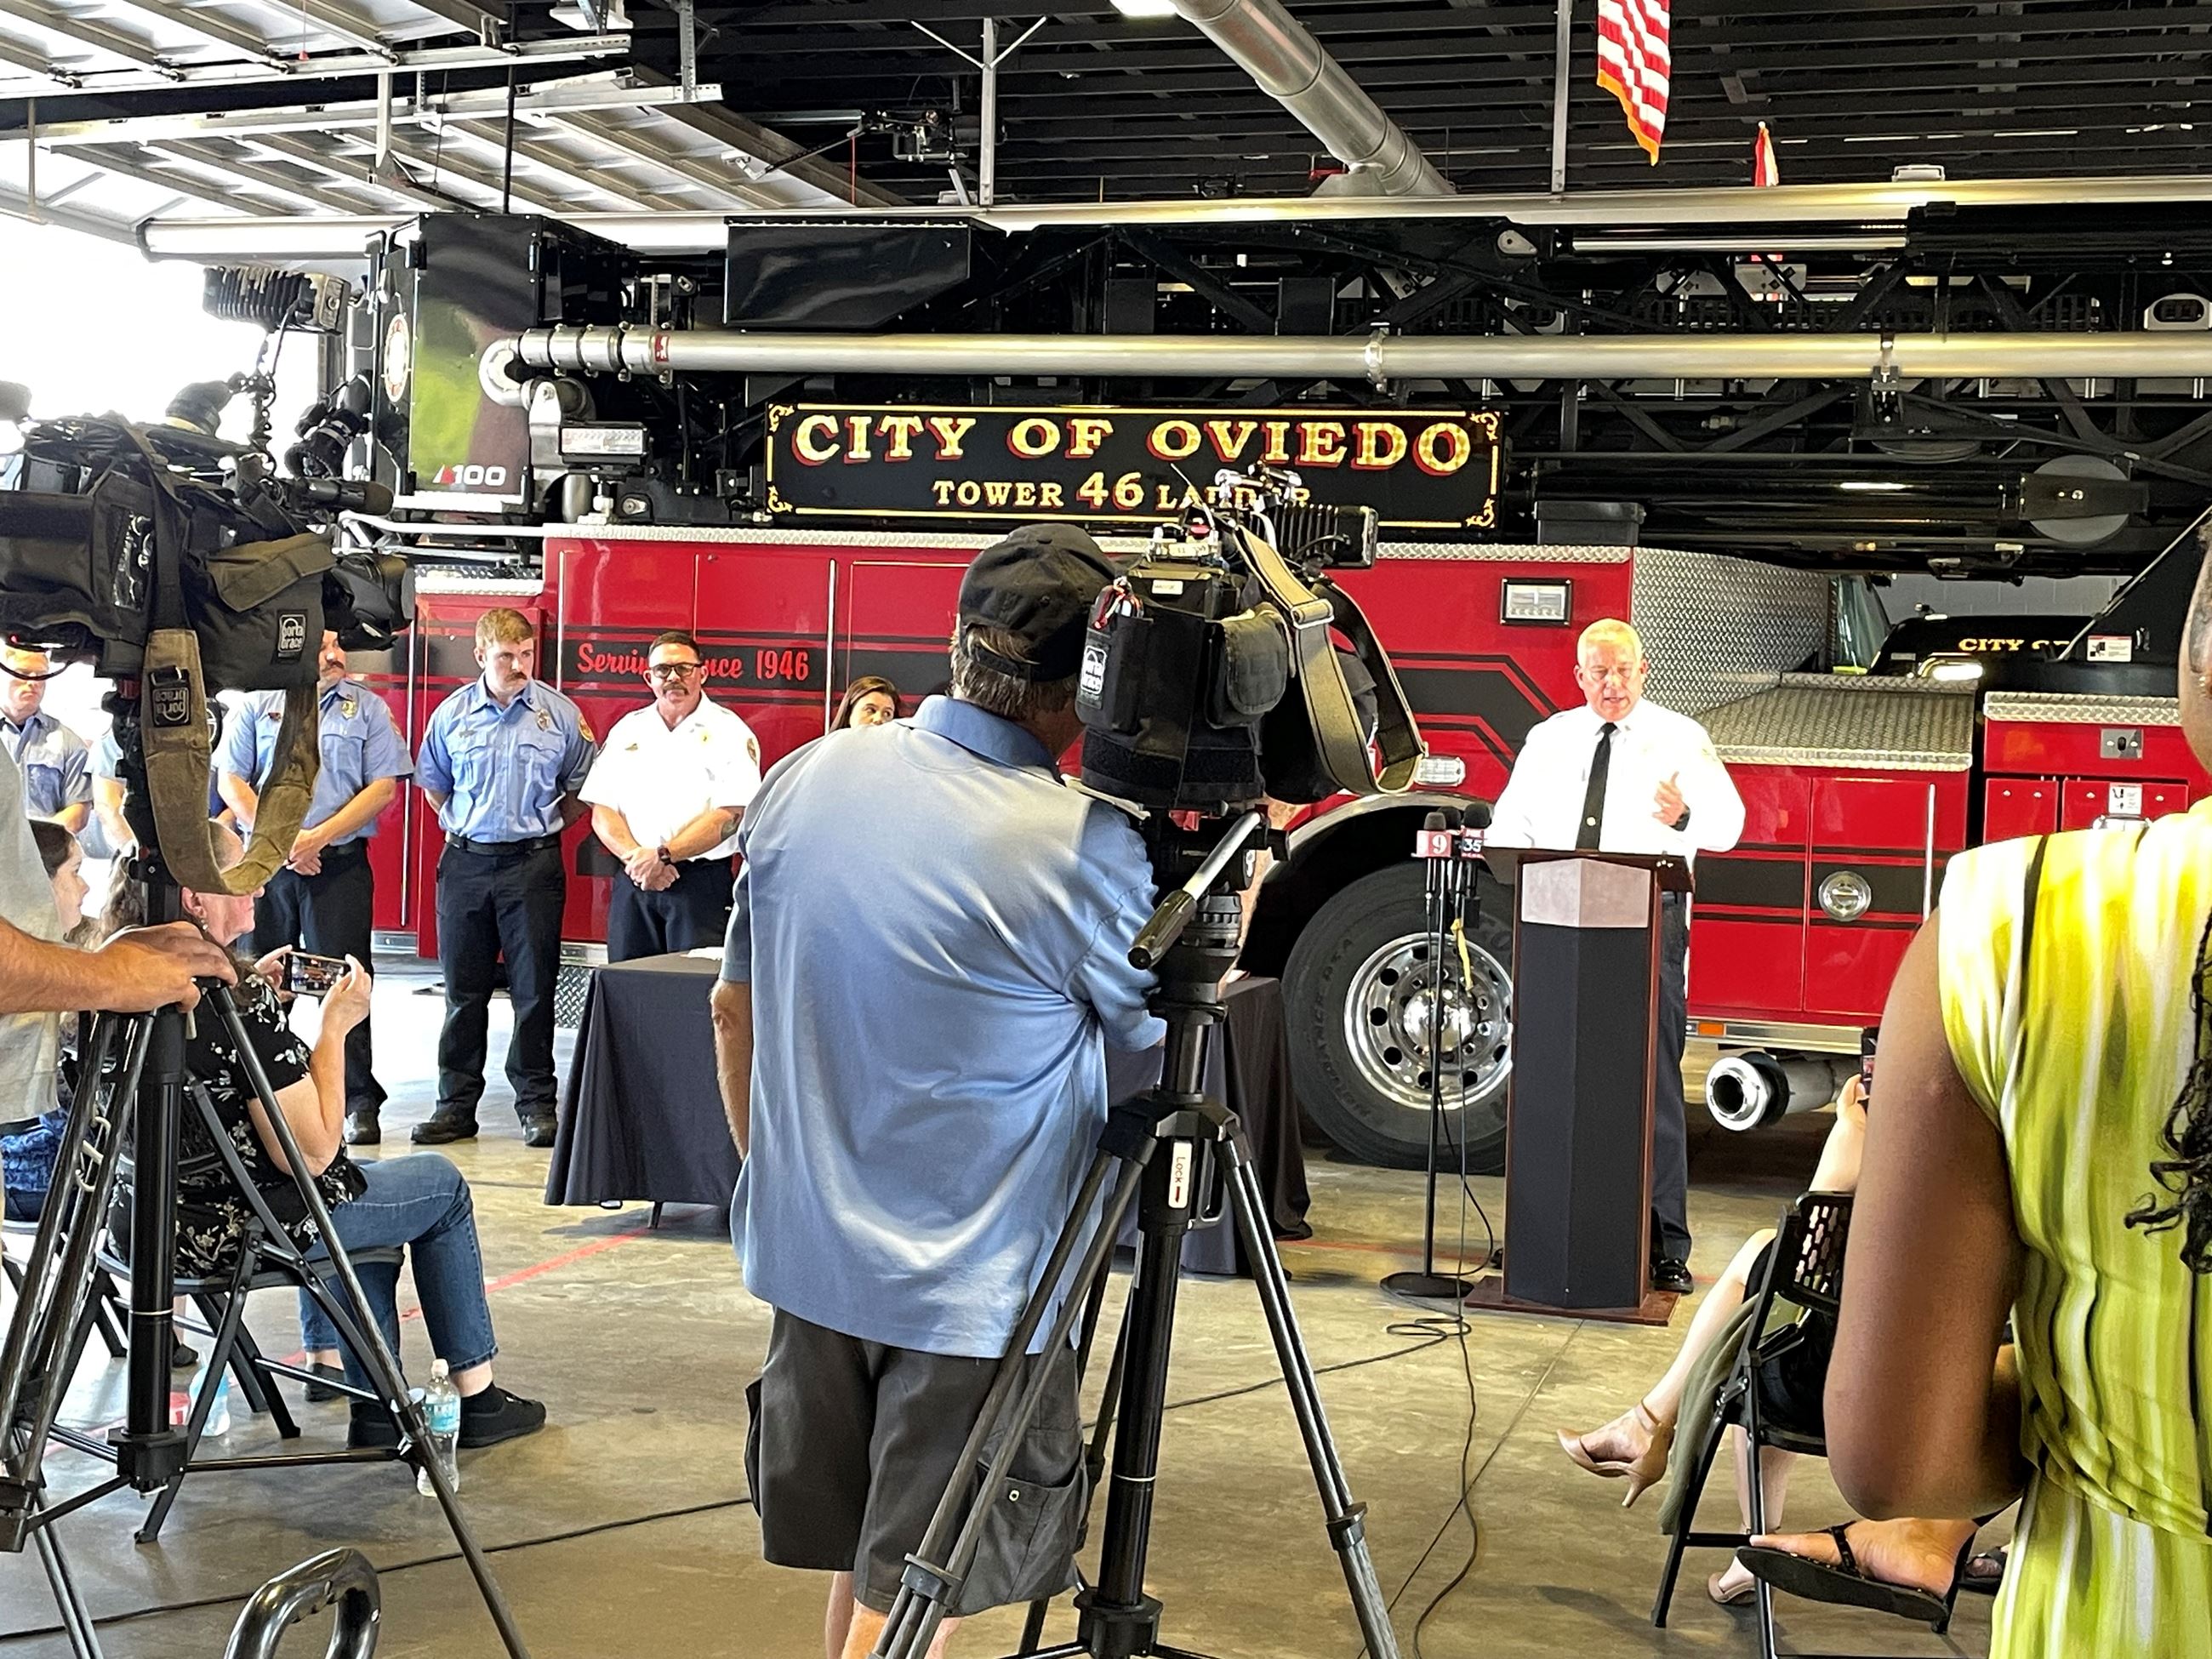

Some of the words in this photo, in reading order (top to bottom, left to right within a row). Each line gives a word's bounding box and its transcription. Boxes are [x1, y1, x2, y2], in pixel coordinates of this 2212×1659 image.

[791, 414, 977, 466] CITY
[1005, 417, 1114, 459] OF
[1146, 419, 1471, 476] OVIEDO
[932, 479, 1064, 508] TOWER
[1075, 471, 1145, 510] 46
[1958, 638, 2025, 652] CITY
[577, 642, 649, 675] Servin
[756, 650, 808, 681] 1946
[1432, 835, 1447, 854] 9
[1462, 838, 1483, 852] 35
